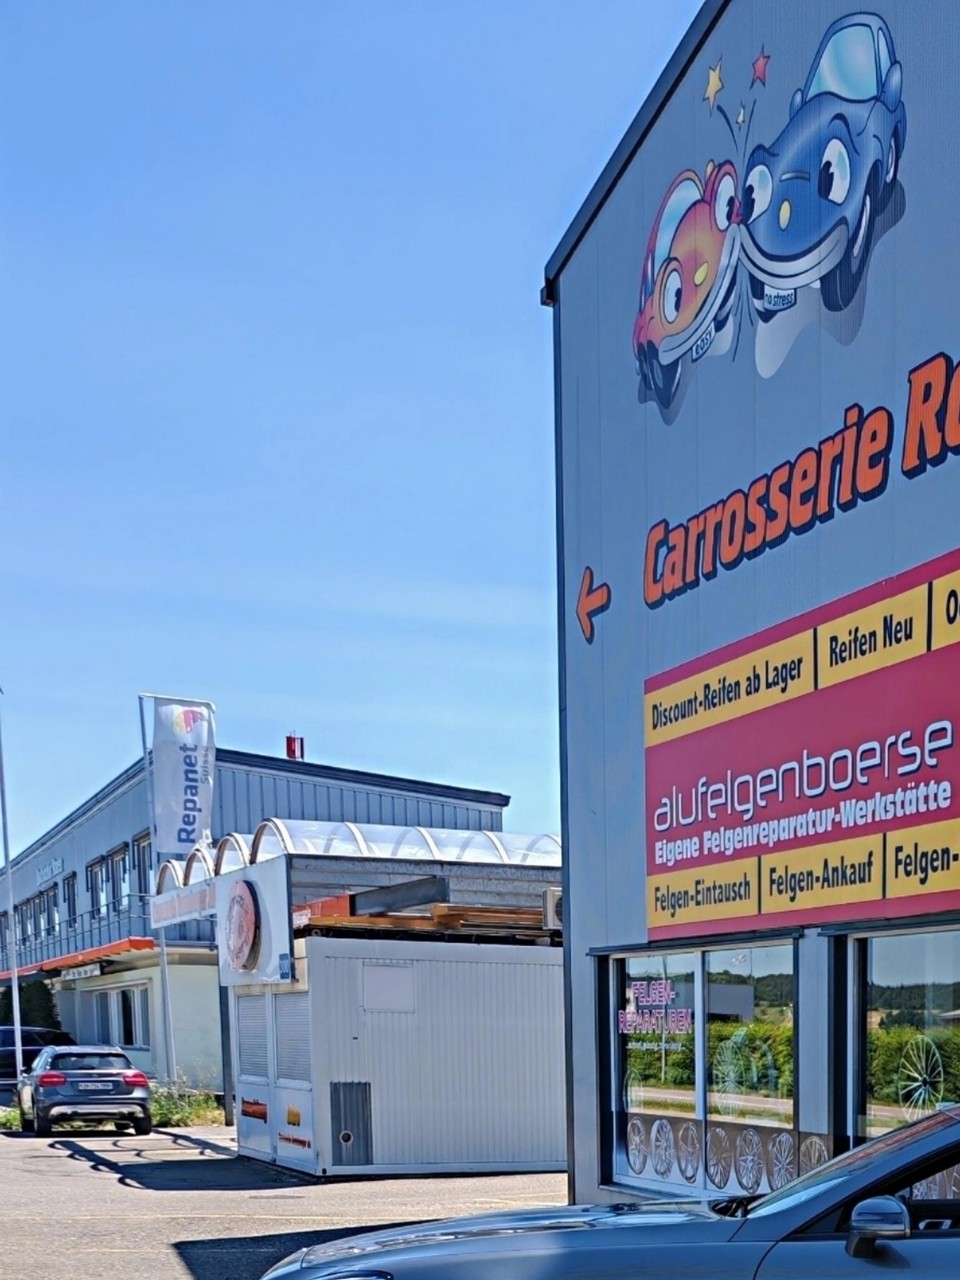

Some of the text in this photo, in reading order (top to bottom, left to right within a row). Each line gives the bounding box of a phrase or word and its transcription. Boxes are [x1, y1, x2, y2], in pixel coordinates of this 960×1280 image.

[643, 403, 893, 609] Carrosserie
[829, 614, 914, 668] Reifen Neu
[651, 656, 803, 731] Discount-Reifen ab Lager
[177, 743, 203, 844] Repanet
[654, 719, 953, 832] alufelgenboerse
[654, 780, 952, 867] Eigene Felgenreparatur-Werkstätte
[654, 872, 751, 918] Felgen-Eintausch
[769, 850, 874, 903] Felgen-Ankauf
[618, 1008, 692, 1034] REPARATUREN
[631, 980, 676, 1005] FELGEN-
